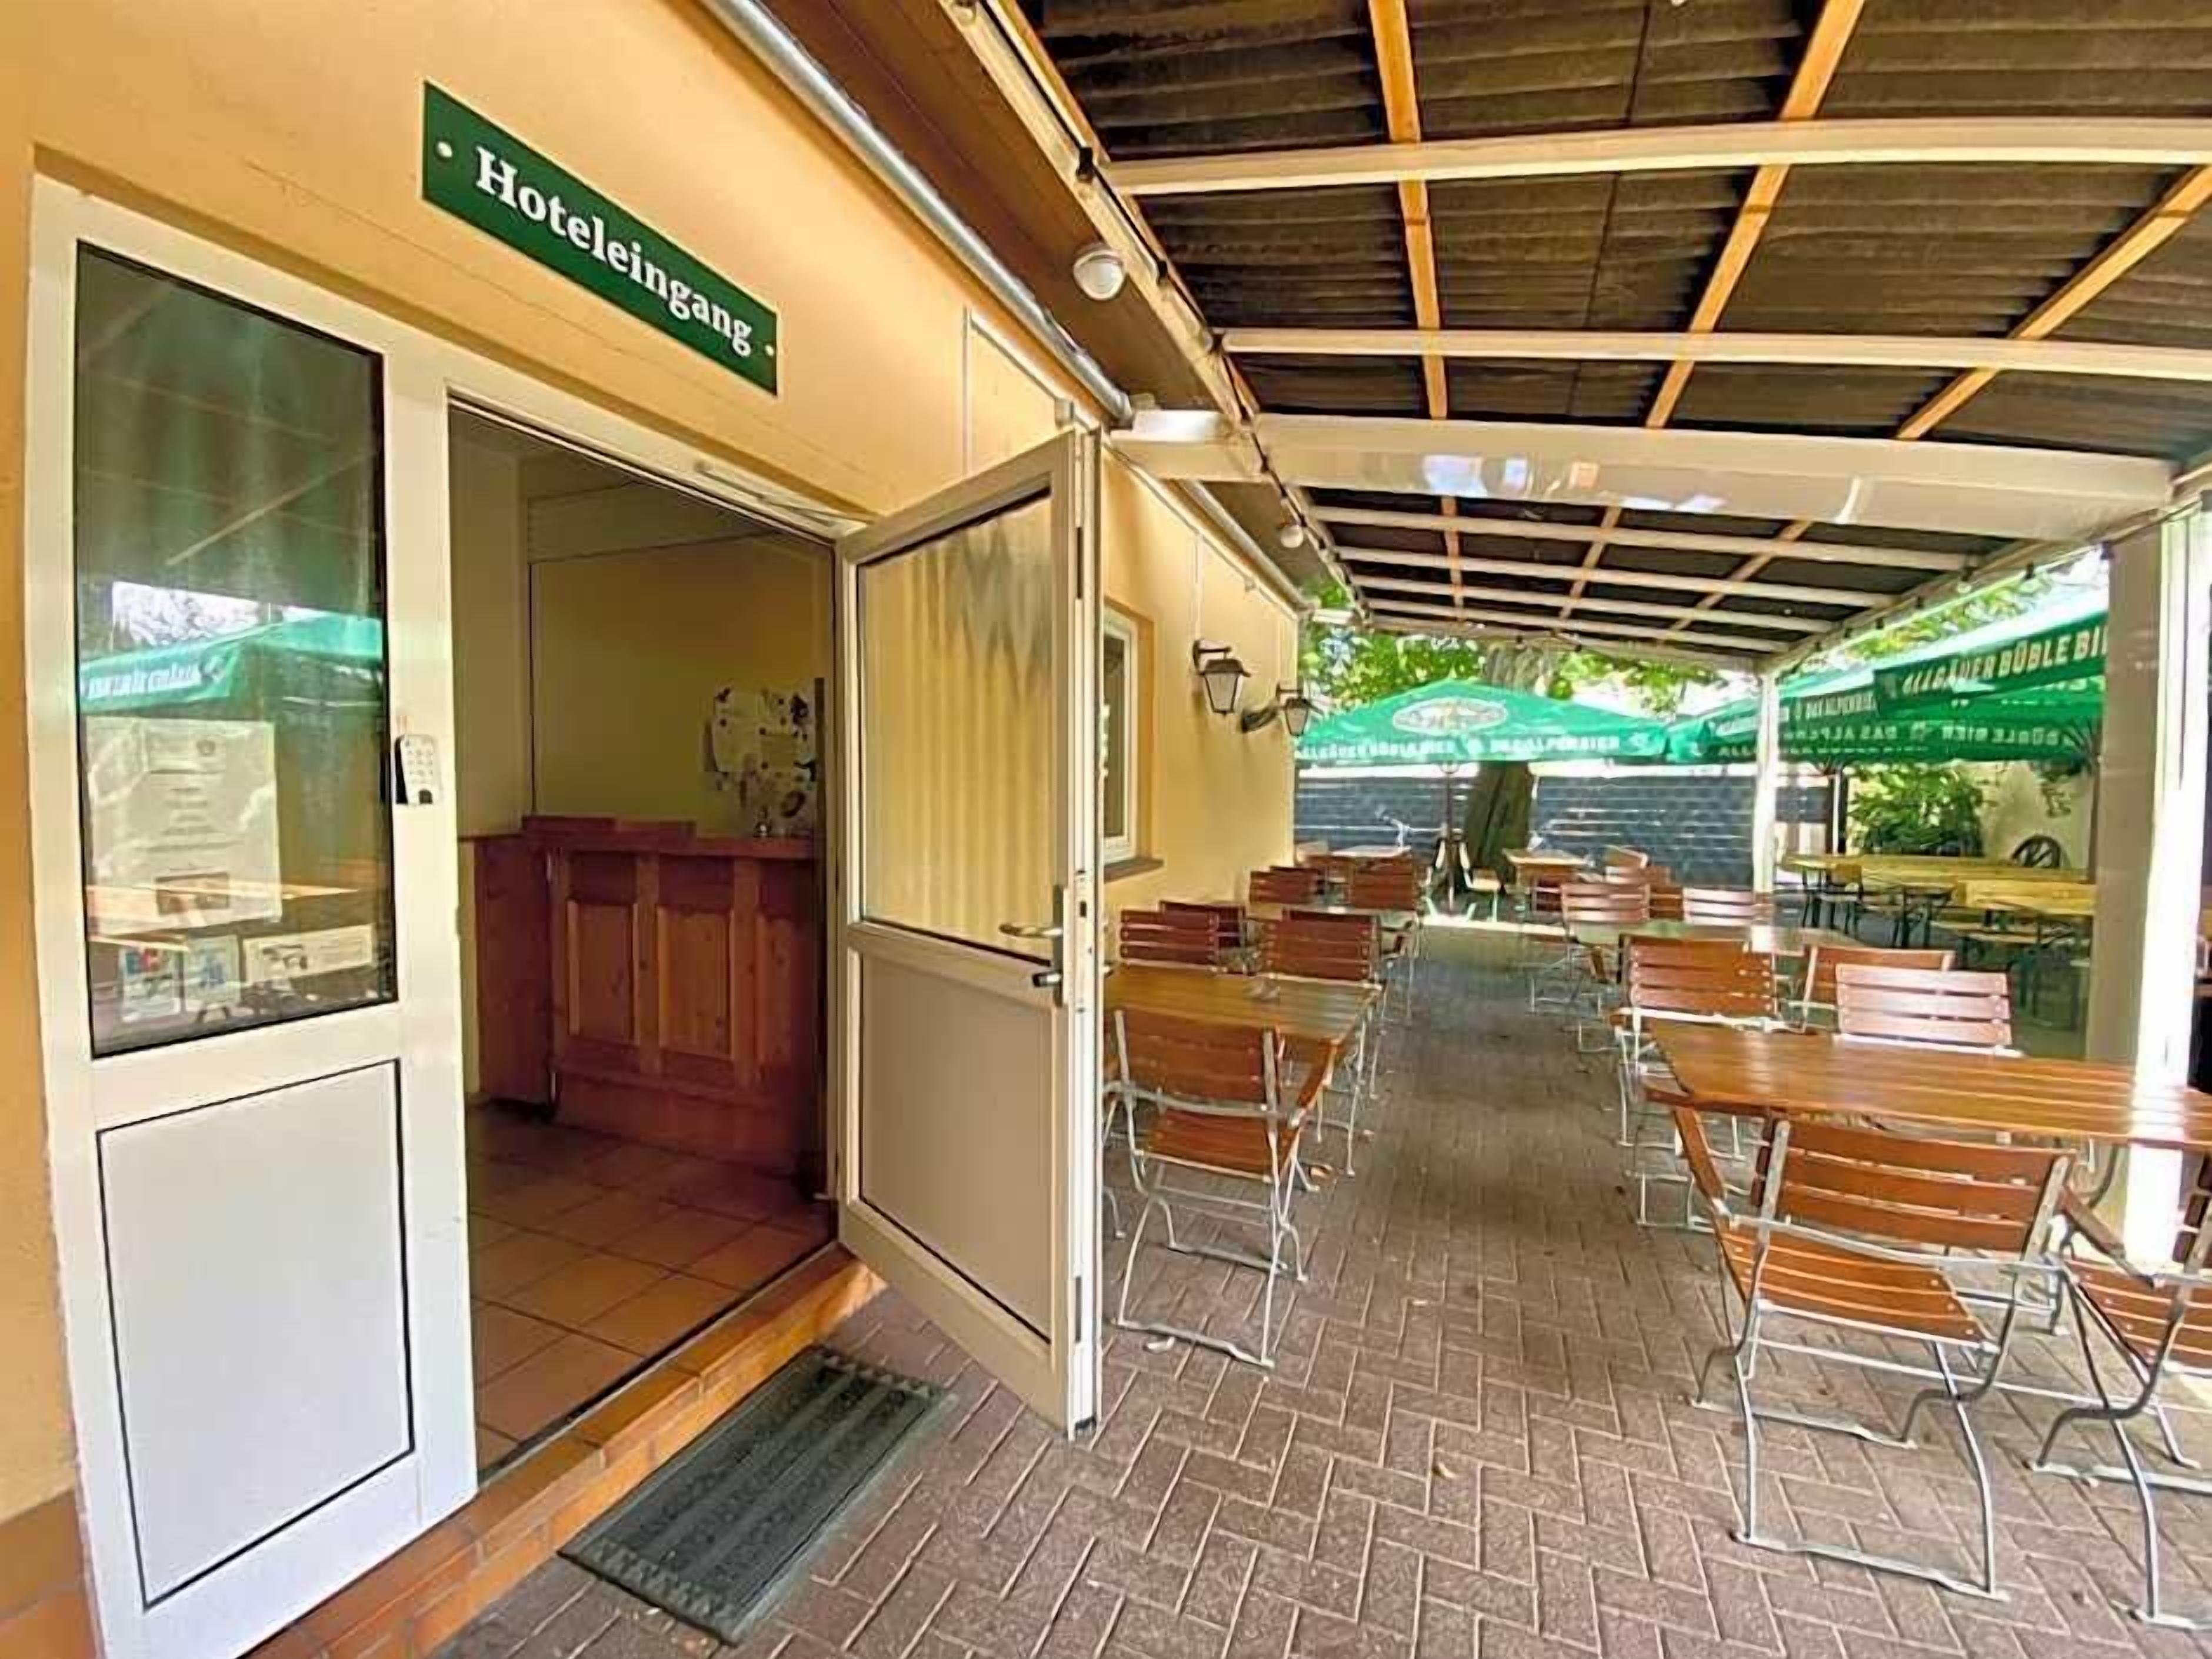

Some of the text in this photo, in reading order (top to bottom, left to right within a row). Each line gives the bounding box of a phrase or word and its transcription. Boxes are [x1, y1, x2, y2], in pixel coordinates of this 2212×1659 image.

[475, 145, 753, 357] Hoteleingang
[1998, 634, 2071, 677] BÜBLE
[2073, 625, 2107, 660] BI
